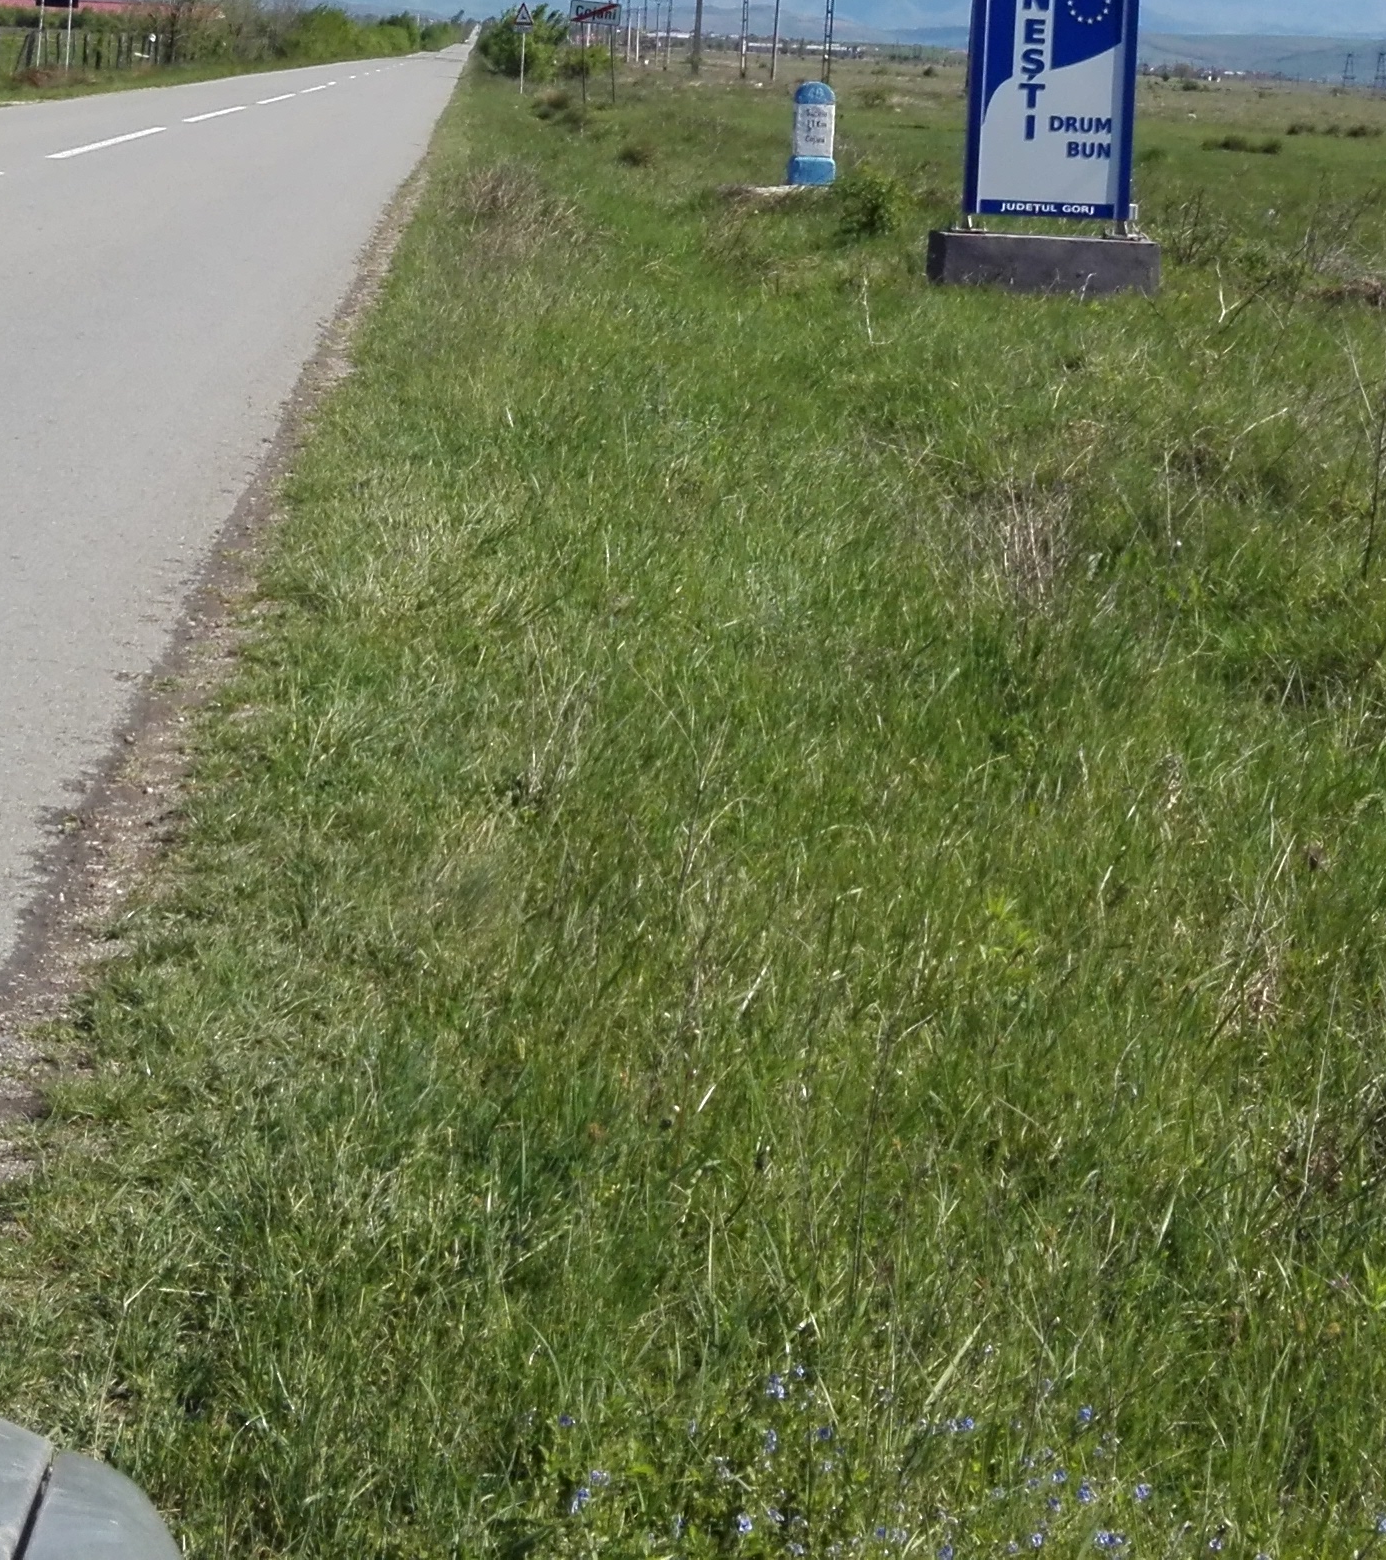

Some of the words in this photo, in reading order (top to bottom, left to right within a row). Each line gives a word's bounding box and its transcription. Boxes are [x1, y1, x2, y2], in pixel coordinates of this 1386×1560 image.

[1049, 115, 1112, 134] DRUM
[1067, 141, 1112, 159] BUN
[1000, 202, 1057, 214] JUDEȚUL
[1061, 204, 1095, 215] GORJ
